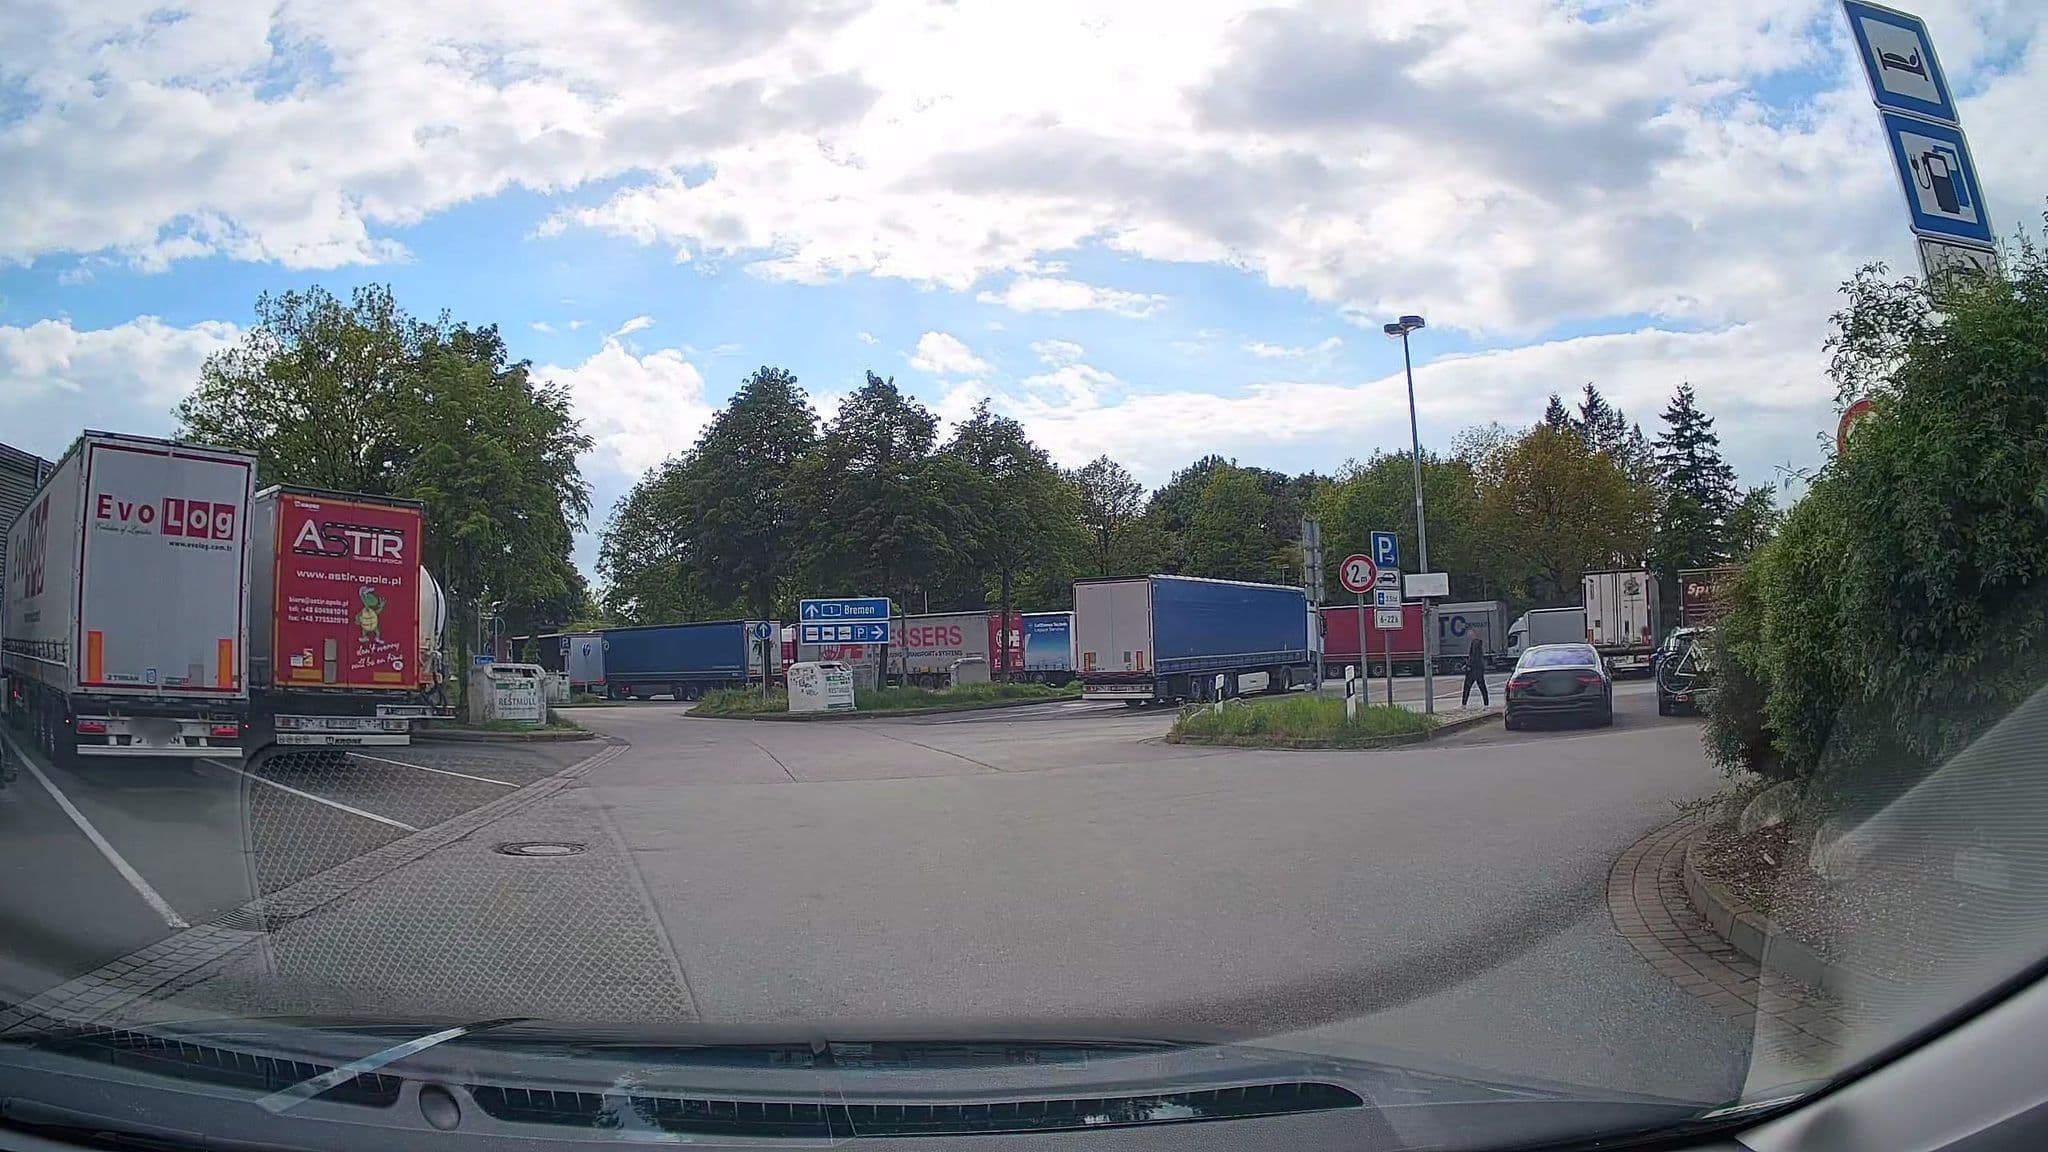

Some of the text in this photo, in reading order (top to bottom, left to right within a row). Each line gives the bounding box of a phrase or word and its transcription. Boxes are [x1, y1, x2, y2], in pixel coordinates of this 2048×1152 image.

[1377, 536, 1392, 562] P
[1351, 564, 1360, 583] 2
[844, 605, 875, 615] Bremen
[857, 628, 865, 637] P
